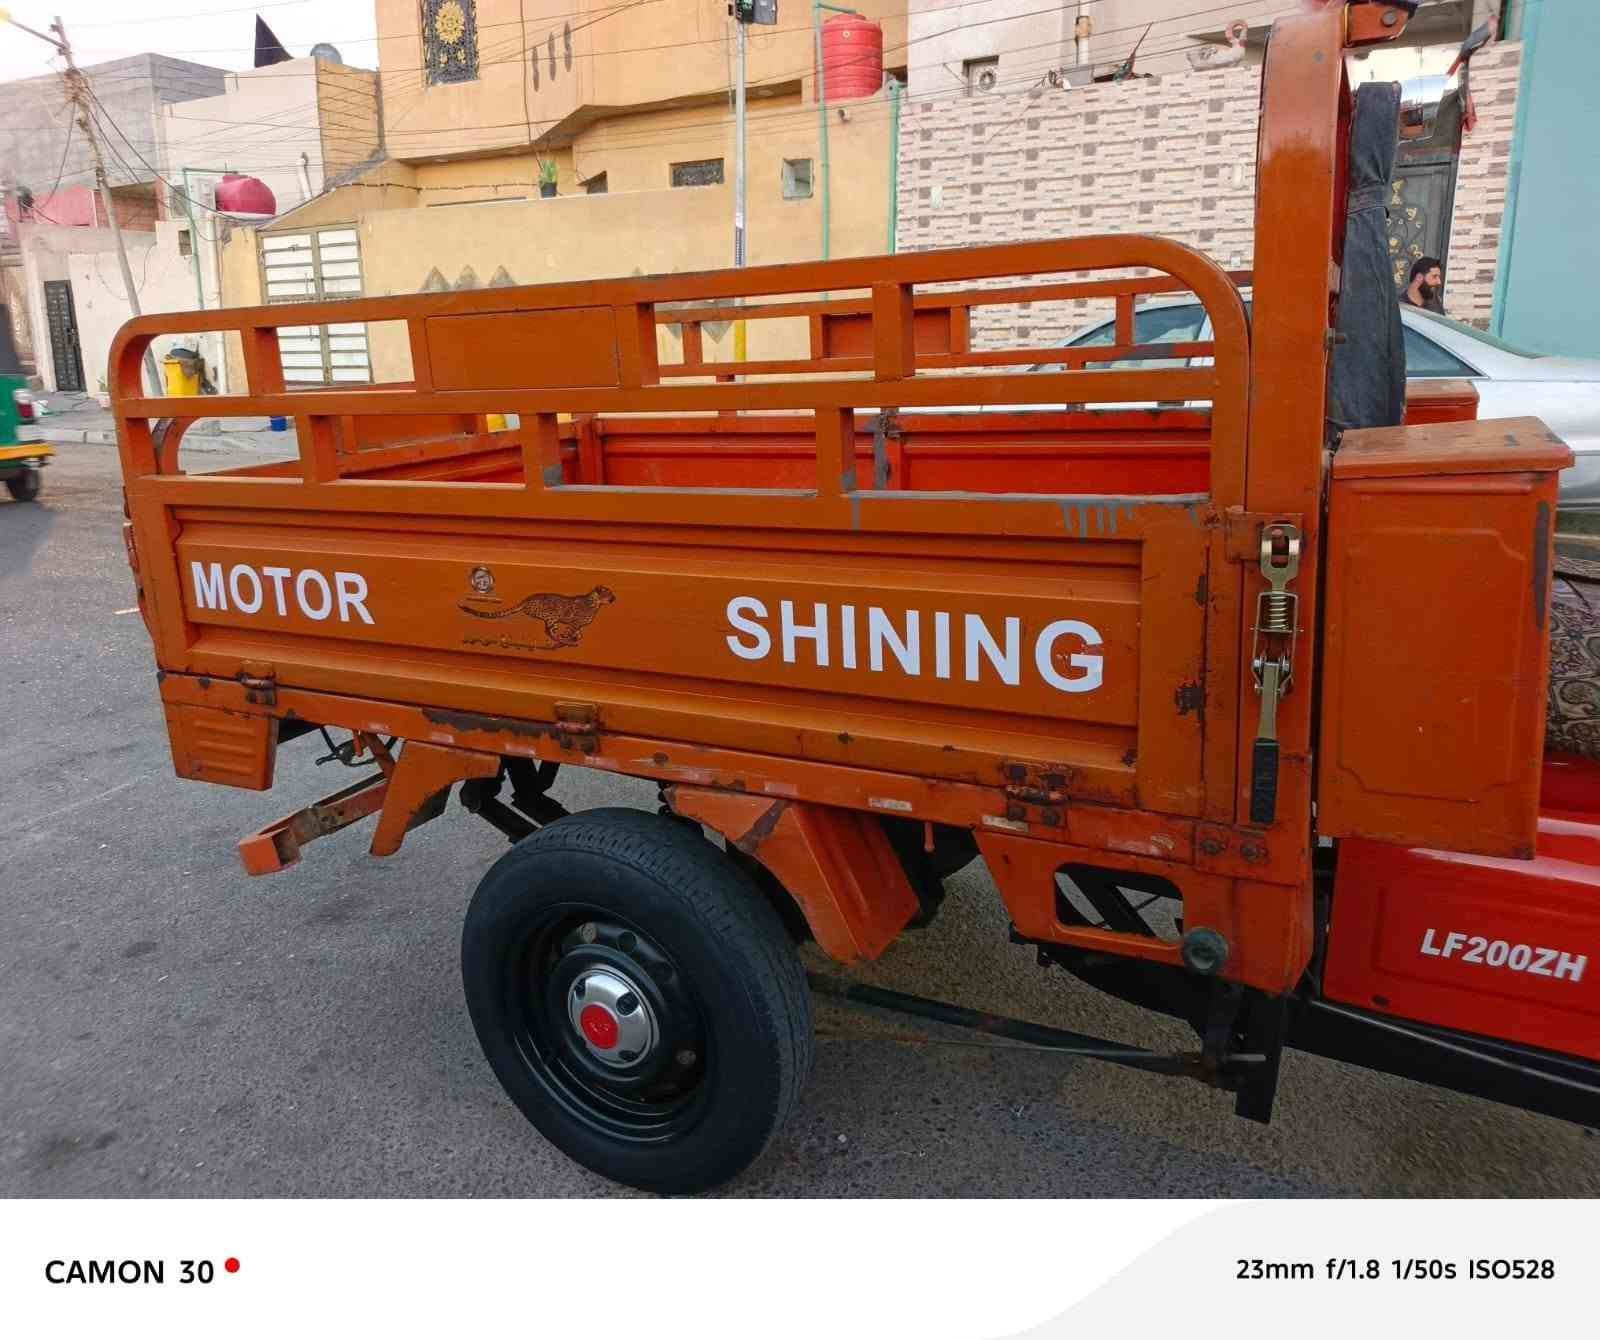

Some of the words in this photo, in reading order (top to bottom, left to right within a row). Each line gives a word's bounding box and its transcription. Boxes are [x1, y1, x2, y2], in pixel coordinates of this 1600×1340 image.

[191, 560, 375, 626] MOTOR
[725, 596, 1105, 693] SHINING
[1420, 928, 1587, 982] LF200ZH
